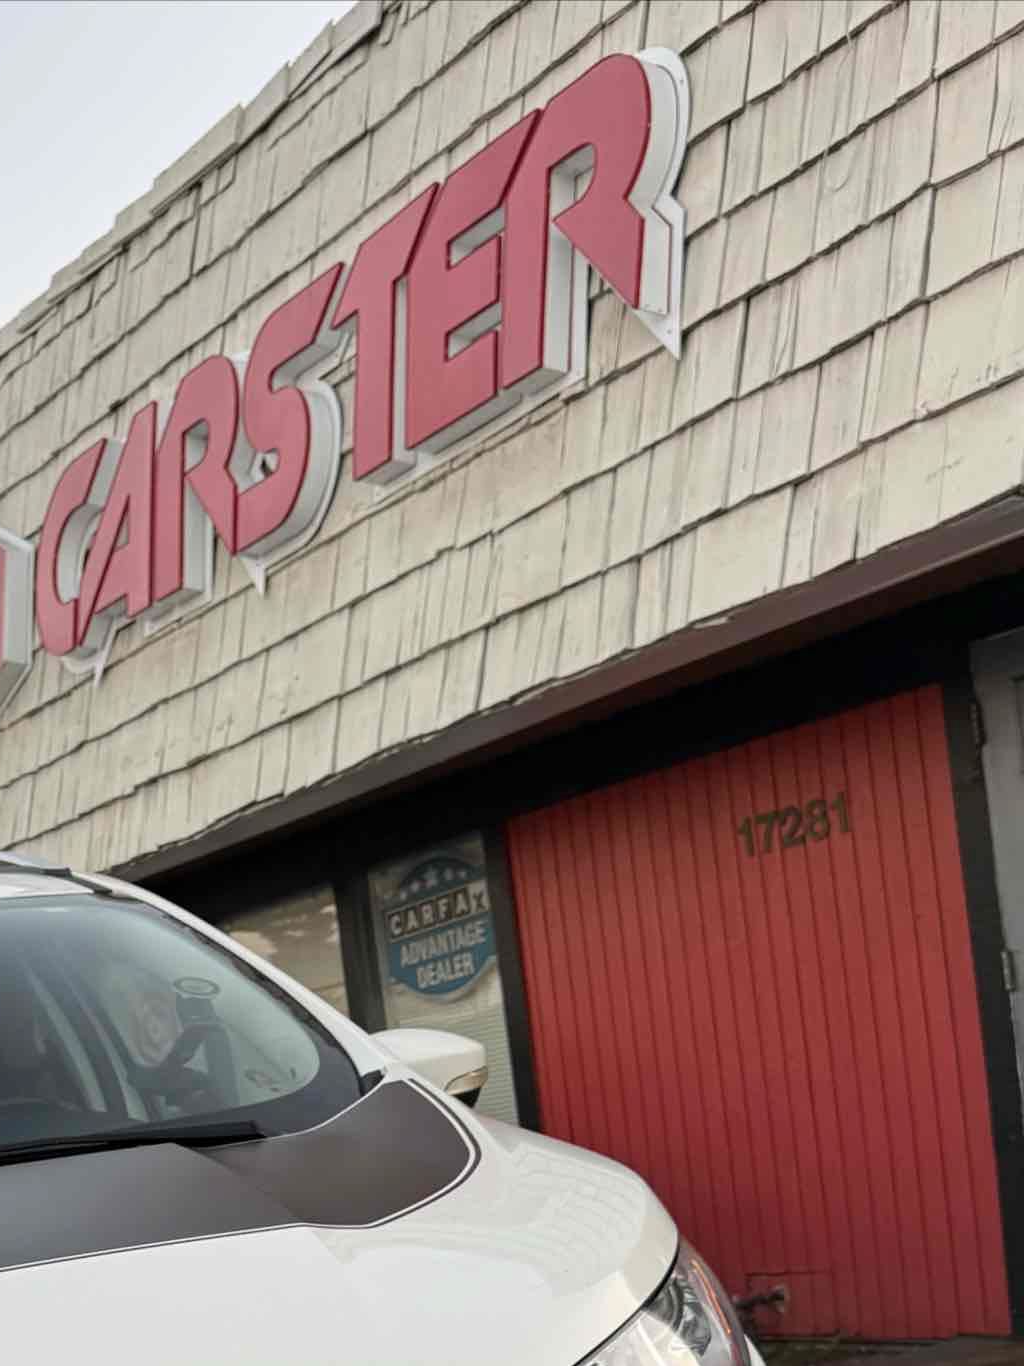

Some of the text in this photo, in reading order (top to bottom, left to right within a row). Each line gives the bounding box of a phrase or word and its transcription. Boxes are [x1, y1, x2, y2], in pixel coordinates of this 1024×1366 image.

[34, 48, 684, 657] CARSTER
[737, 791, 848, 857] 17281
[389, 882, 490, 936] CARFAX
[400, 920, 486, 968] ADVANTAGE
[416, 952, 474, 988] DEALER
